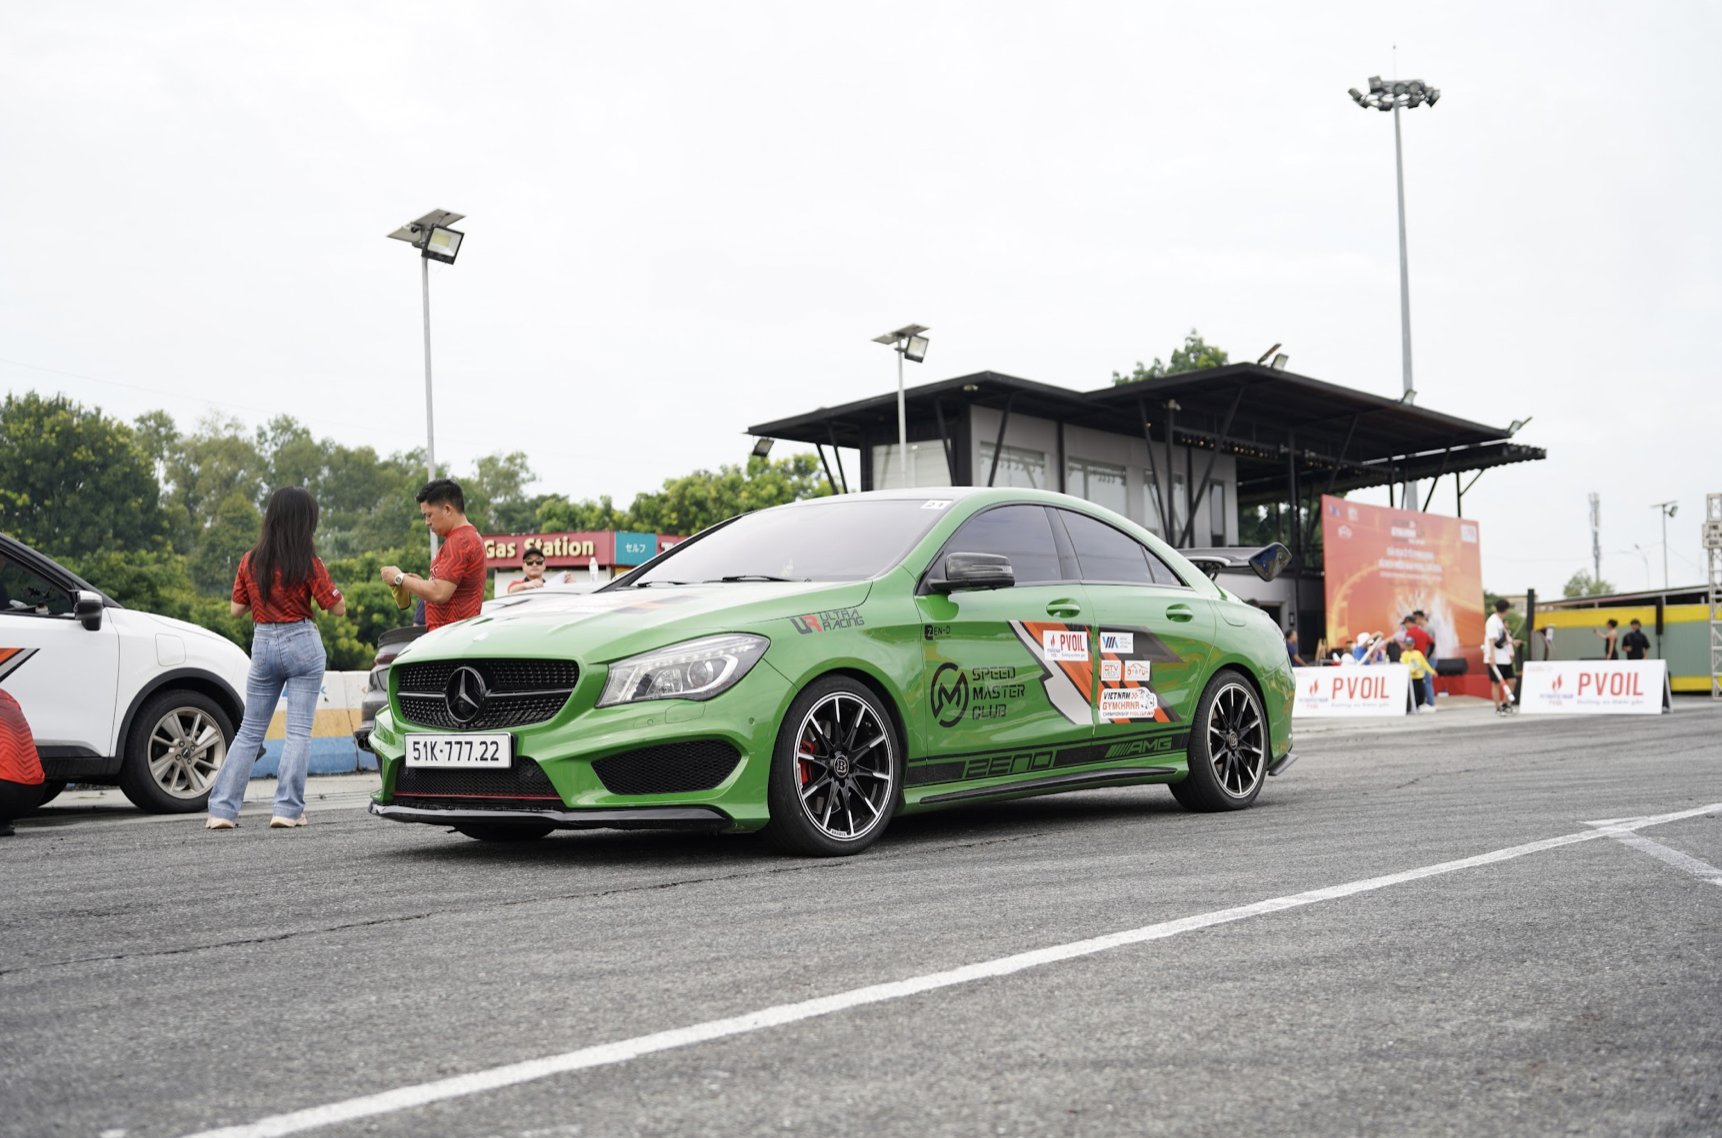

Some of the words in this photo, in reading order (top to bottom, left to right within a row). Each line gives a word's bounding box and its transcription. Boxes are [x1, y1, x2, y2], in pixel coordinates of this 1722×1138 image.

[484, 539, 516, 559] Gas
[523, 537, 594, 557] Station
[625, 543, 646, 553] セルフ
[820, 608, 860, 621] ULTRA
[822, 616, 865, 632] RACING
[1060, 634, 1085, 652] PVOIL
[972, 666, 1016, 681] SPEED
[972, 684, 1025, 701] MASTER
[1331, 676, 1390, 700] PVOIL
[1577, 672, 1645, 696] PVOIL
[1103, 691, 1131, 700] VIETNAM
[972, 703, 1007, 720] CLUB
